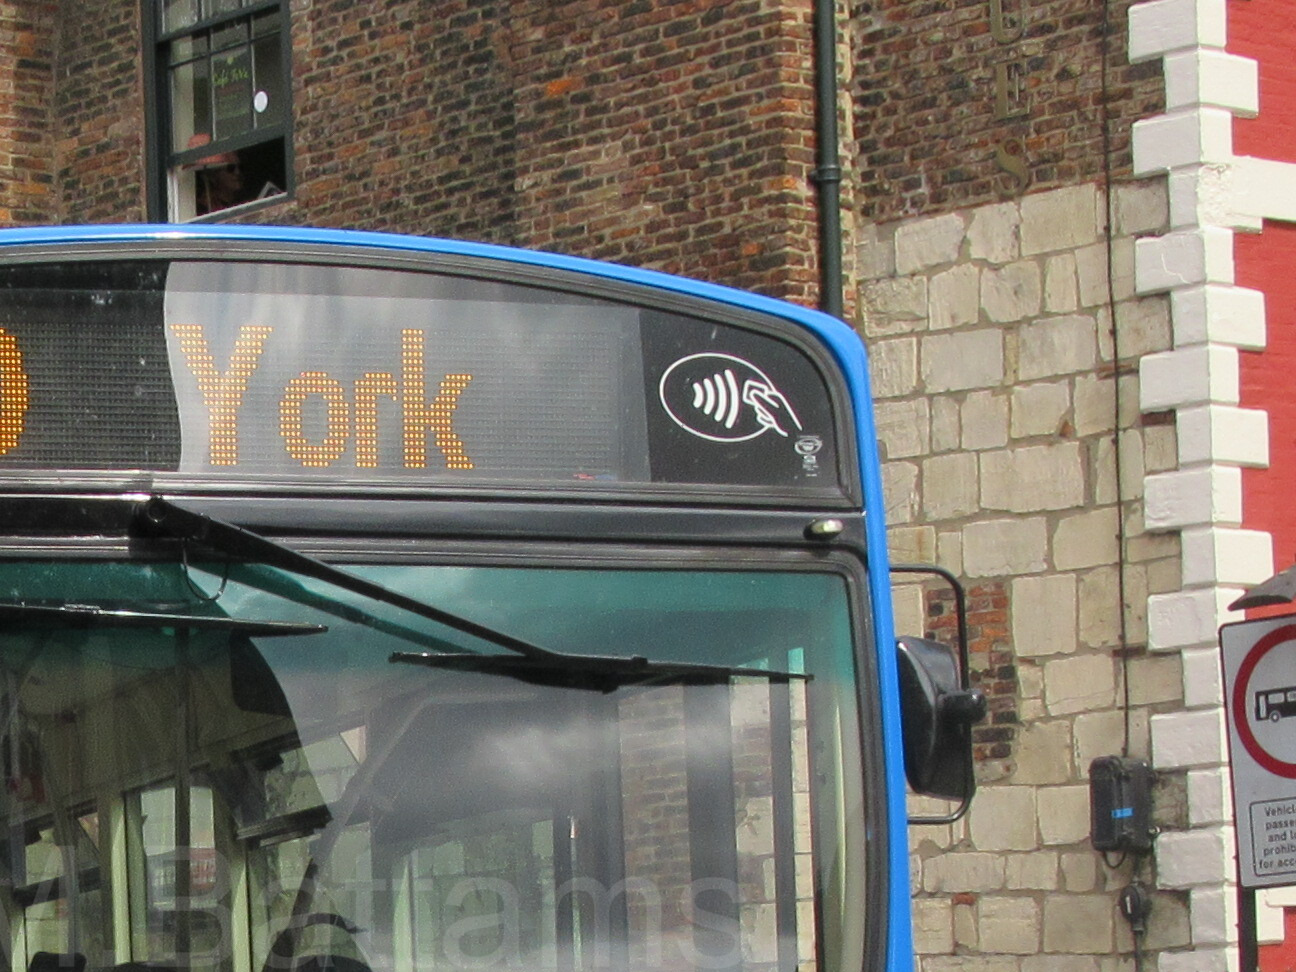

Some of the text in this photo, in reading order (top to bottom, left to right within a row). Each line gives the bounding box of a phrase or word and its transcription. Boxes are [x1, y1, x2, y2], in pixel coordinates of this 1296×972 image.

[169, 323, 473, 471] York
[1265, 819, 1296, 831] passe
[1268, 830, 1287, 842] and
[1259, 857, 1296, 869] for acc
